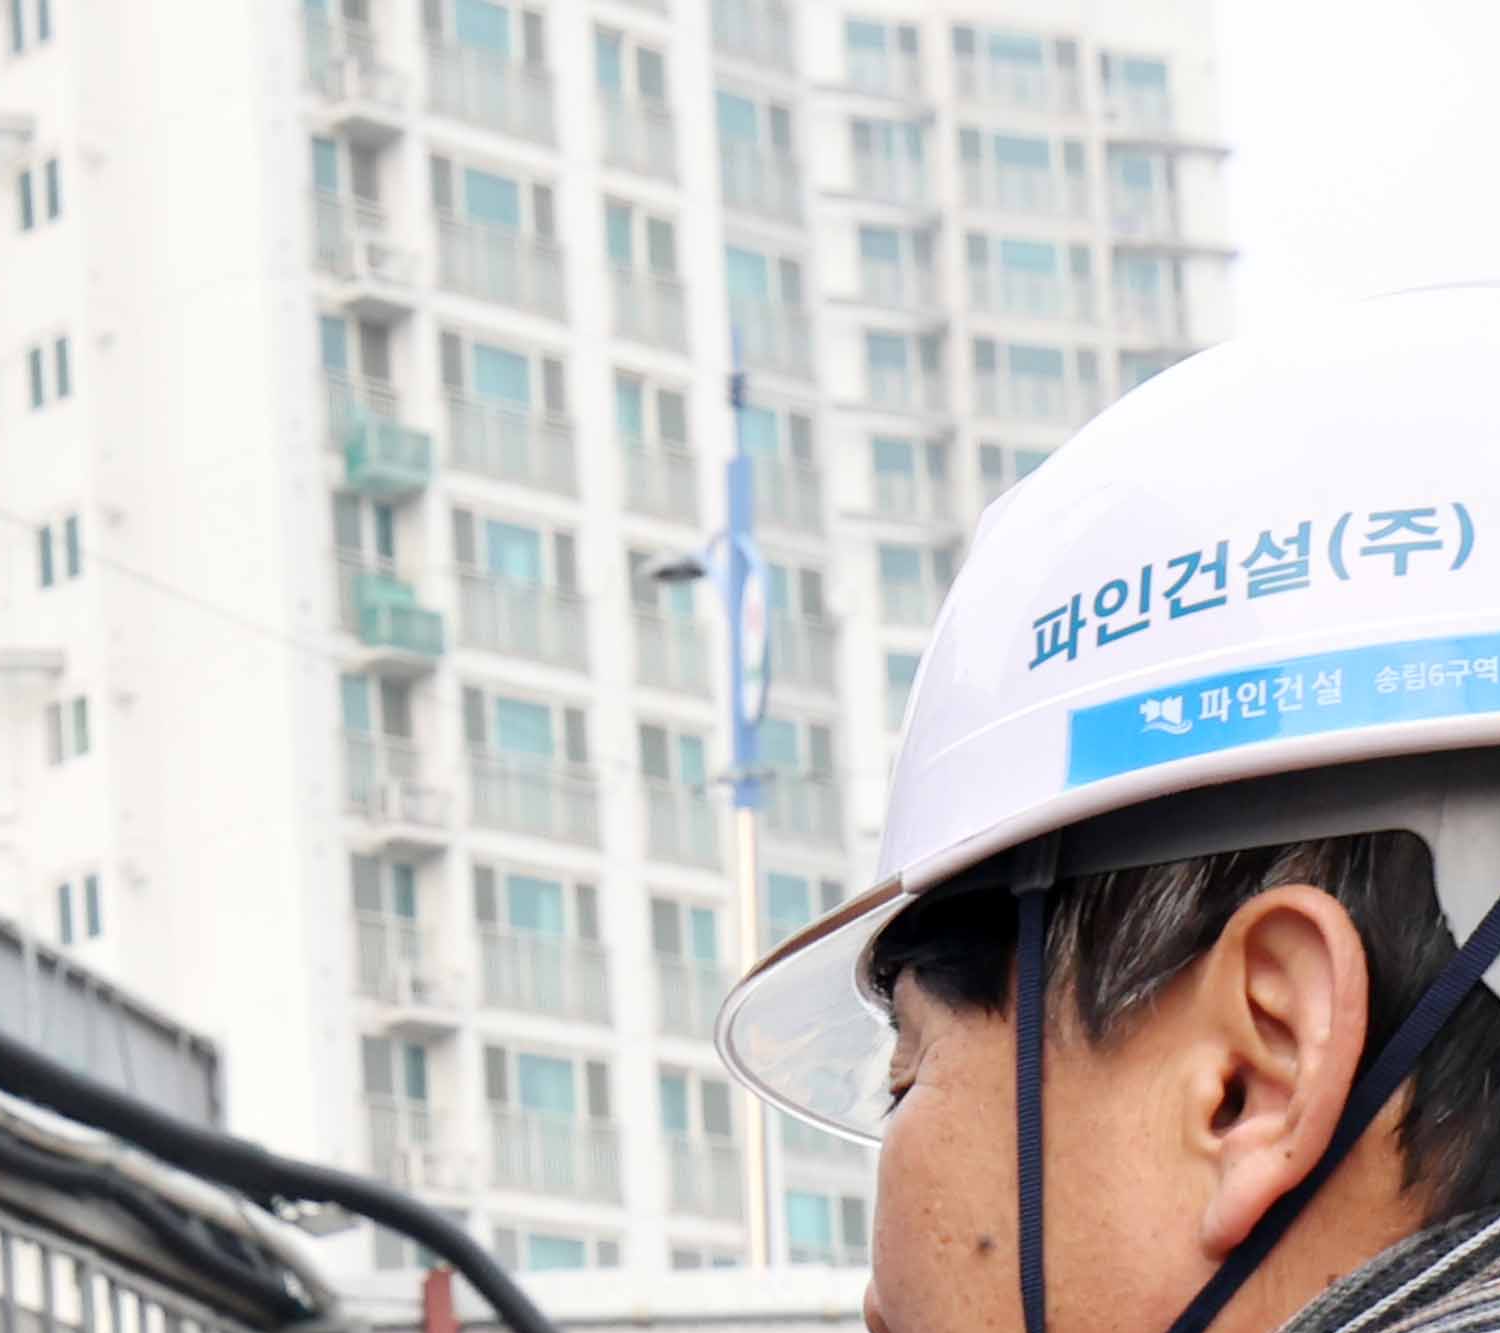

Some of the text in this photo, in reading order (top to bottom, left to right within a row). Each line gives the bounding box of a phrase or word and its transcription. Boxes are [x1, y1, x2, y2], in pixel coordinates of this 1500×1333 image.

[1029, 502, 1475, 670] 파인건설(주)
[1199, 668, 1344, 724] 파인건설
[1373, 655, 1500, 694] 송림6구역
